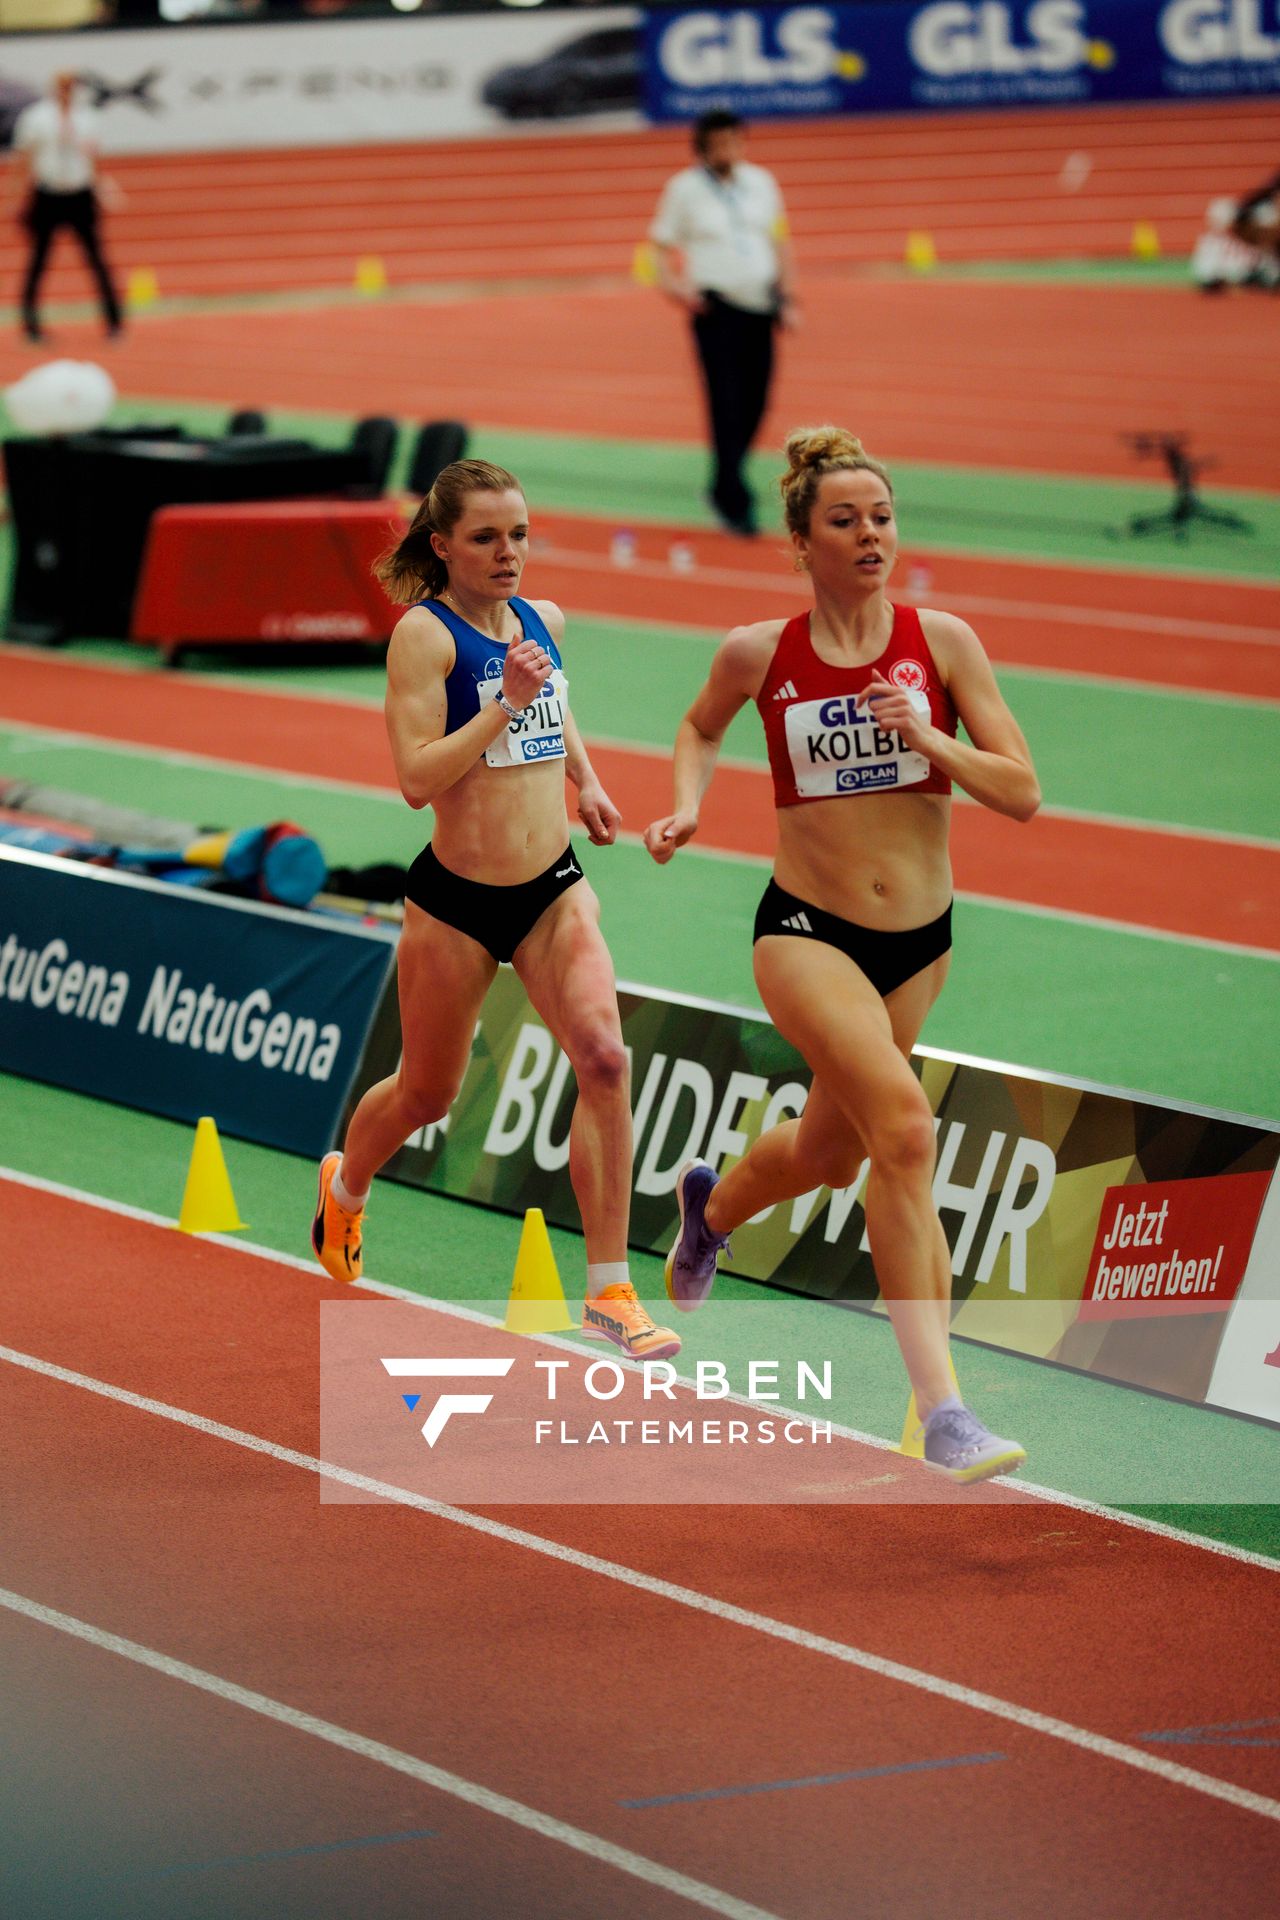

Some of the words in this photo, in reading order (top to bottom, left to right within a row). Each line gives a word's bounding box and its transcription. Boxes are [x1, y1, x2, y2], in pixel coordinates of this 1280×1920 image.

[1157, 0, 1280, 65] GL
[861, 766, 896, 782] PLAN
[0, 934, 129, 1027] tuGena
[137, 964, 341, 1082] NatuGena
[1103, 1199, 1169, 1251] Jetzt
[1091, 1245, 1224, 1301] bewerben!
